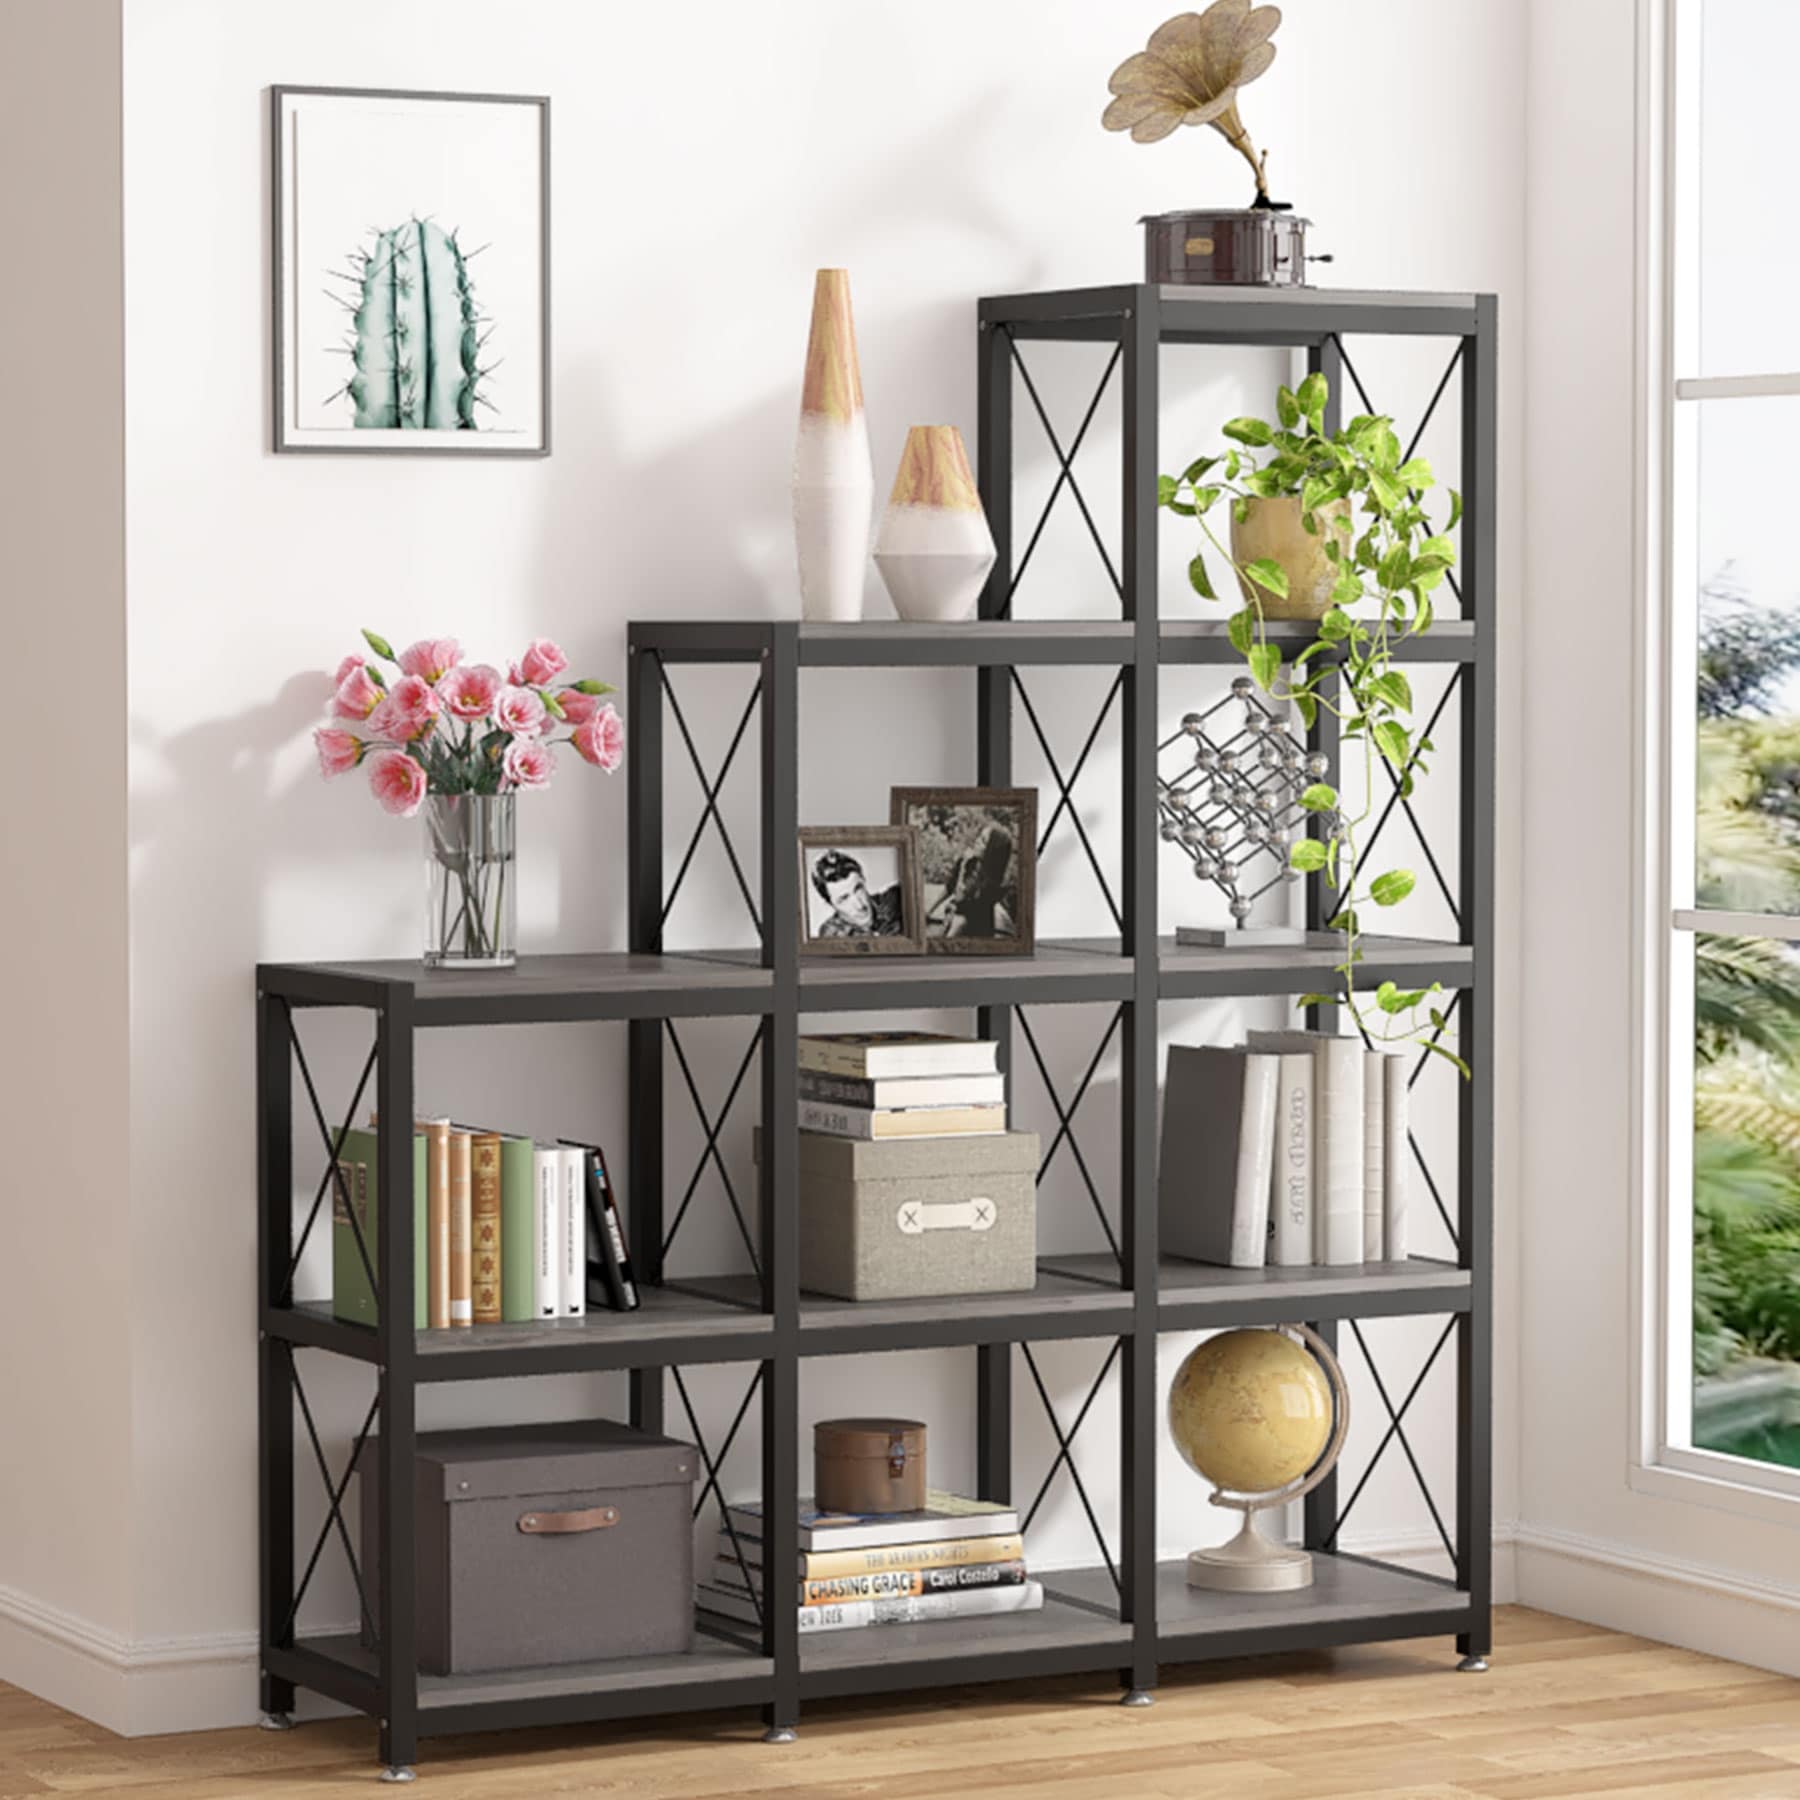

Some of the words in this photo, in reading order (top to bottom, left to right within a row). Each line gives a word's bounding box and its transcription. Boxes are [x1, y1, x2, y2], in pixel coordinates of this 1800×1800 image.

[809, 1575, 869, 1600] CHASING
[872, 1572, 915, 1594] GRACE
[930, 1567, 957, 1587] Carol
